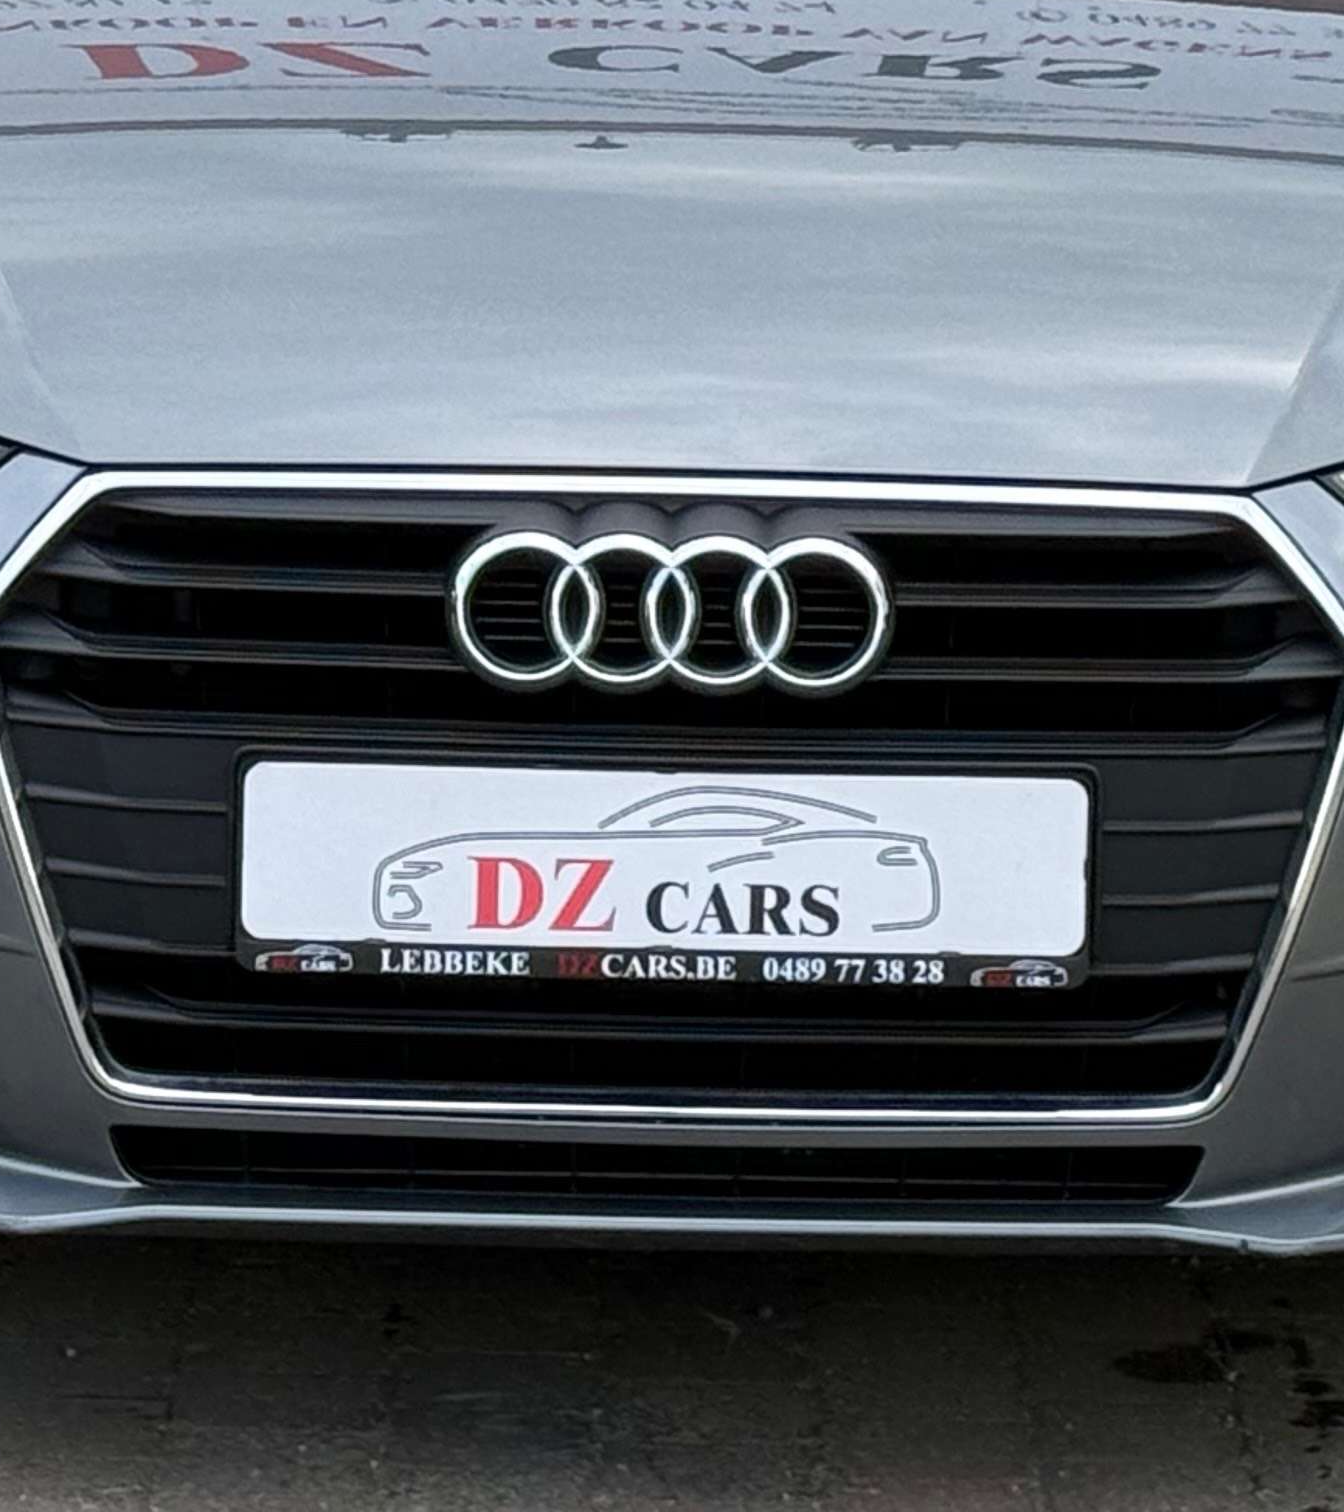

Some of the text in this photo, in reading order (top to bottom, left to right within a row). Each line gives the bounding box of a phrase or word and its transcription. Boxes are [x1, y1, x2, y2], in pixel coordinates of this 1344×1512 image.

[467, 855, 841, 937] DZ CARS
[379, 947, 532, 976] LEBBEKE
[761, 956, 827, 983] 0489
[833, 957, 867, 984] 77
[870, 958, 906, 985] 38
[911, 959, 946, 985] 28
